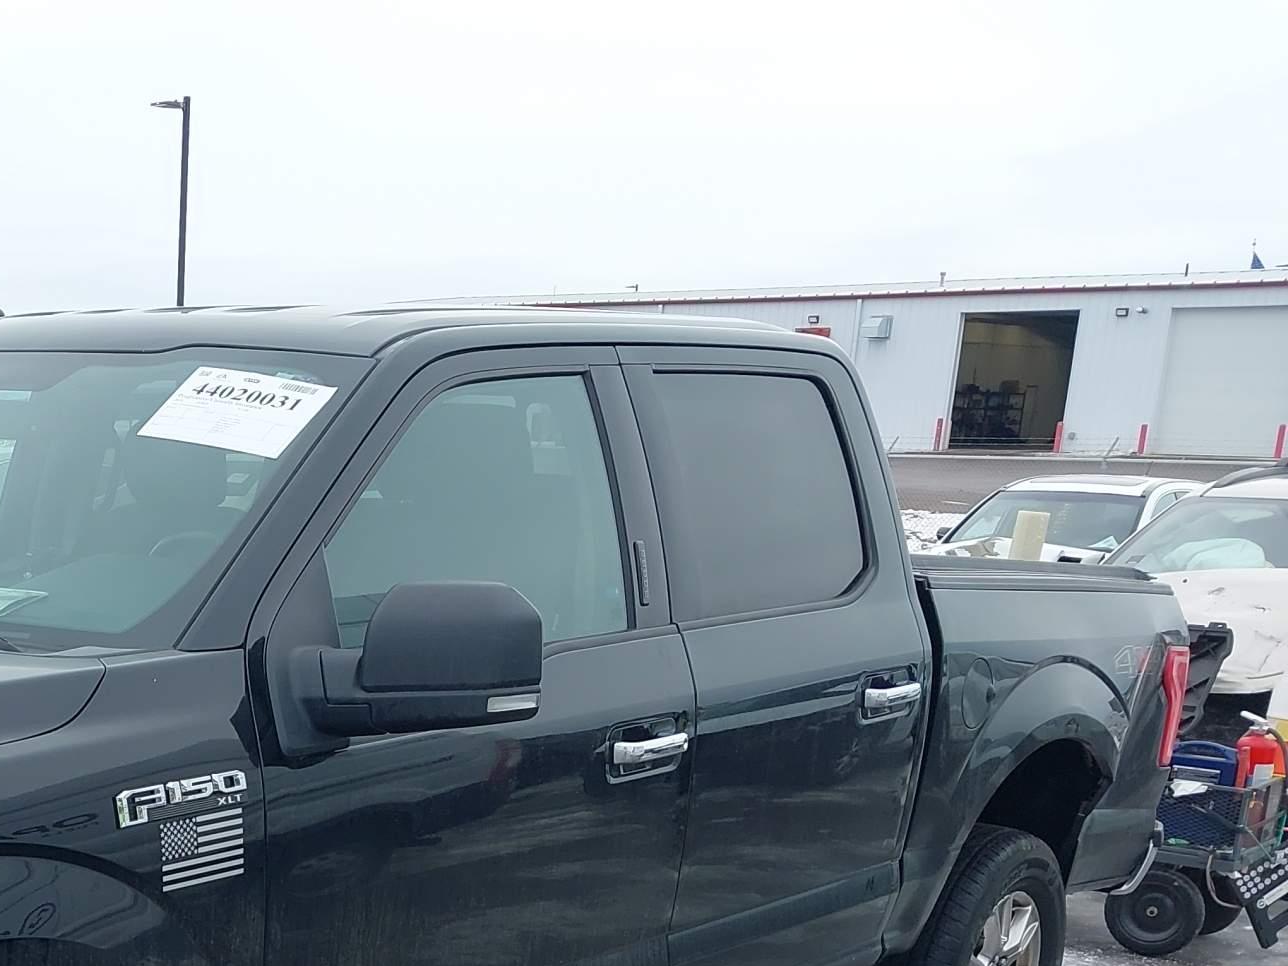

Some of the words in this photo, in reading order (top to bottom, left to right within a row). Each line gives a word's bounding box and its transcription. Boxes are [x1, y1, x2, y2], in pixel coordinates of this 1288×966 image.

[192, 382, 303, 411] 44020031
[115, 769, 248, 829] F150
[217, 793, 244, 806] XLT
